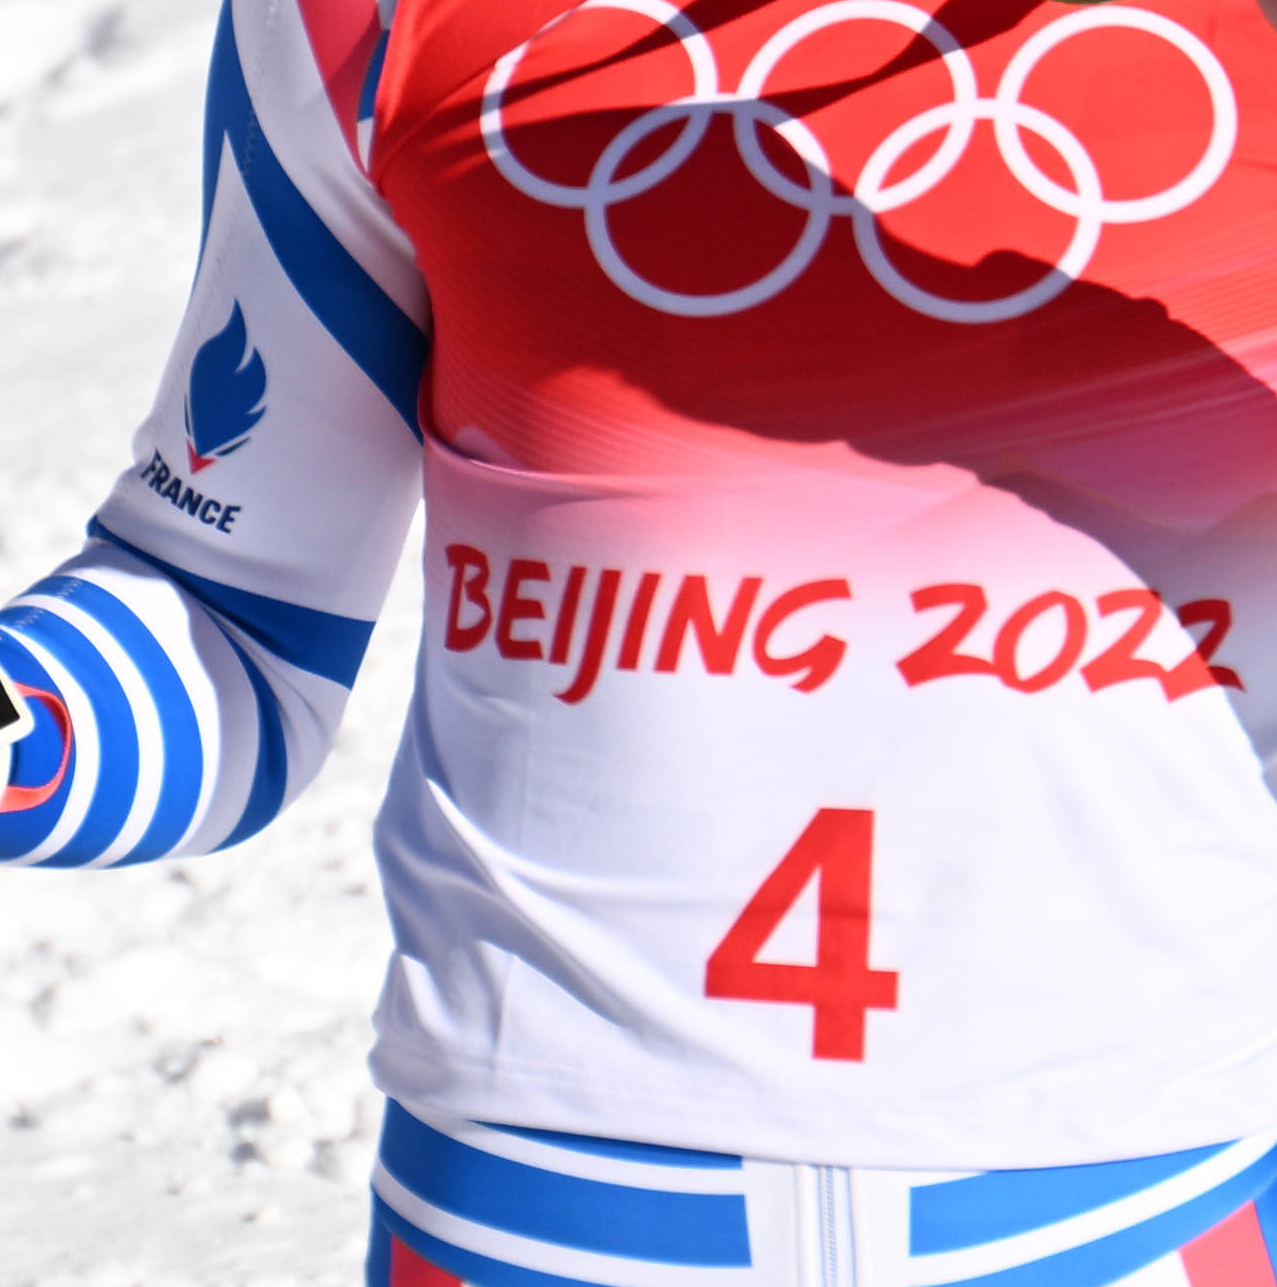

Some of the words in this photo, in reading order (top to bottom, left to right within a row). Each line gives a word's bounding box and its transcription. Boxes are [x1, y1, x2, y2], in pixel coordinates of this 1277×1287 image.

[140, 448, 242, 533] FRANCE
[445, 544, 852, 704] BEIJING
[896, 582, 1246, 702] 2022
[704, 807, 899, 1063] 4
